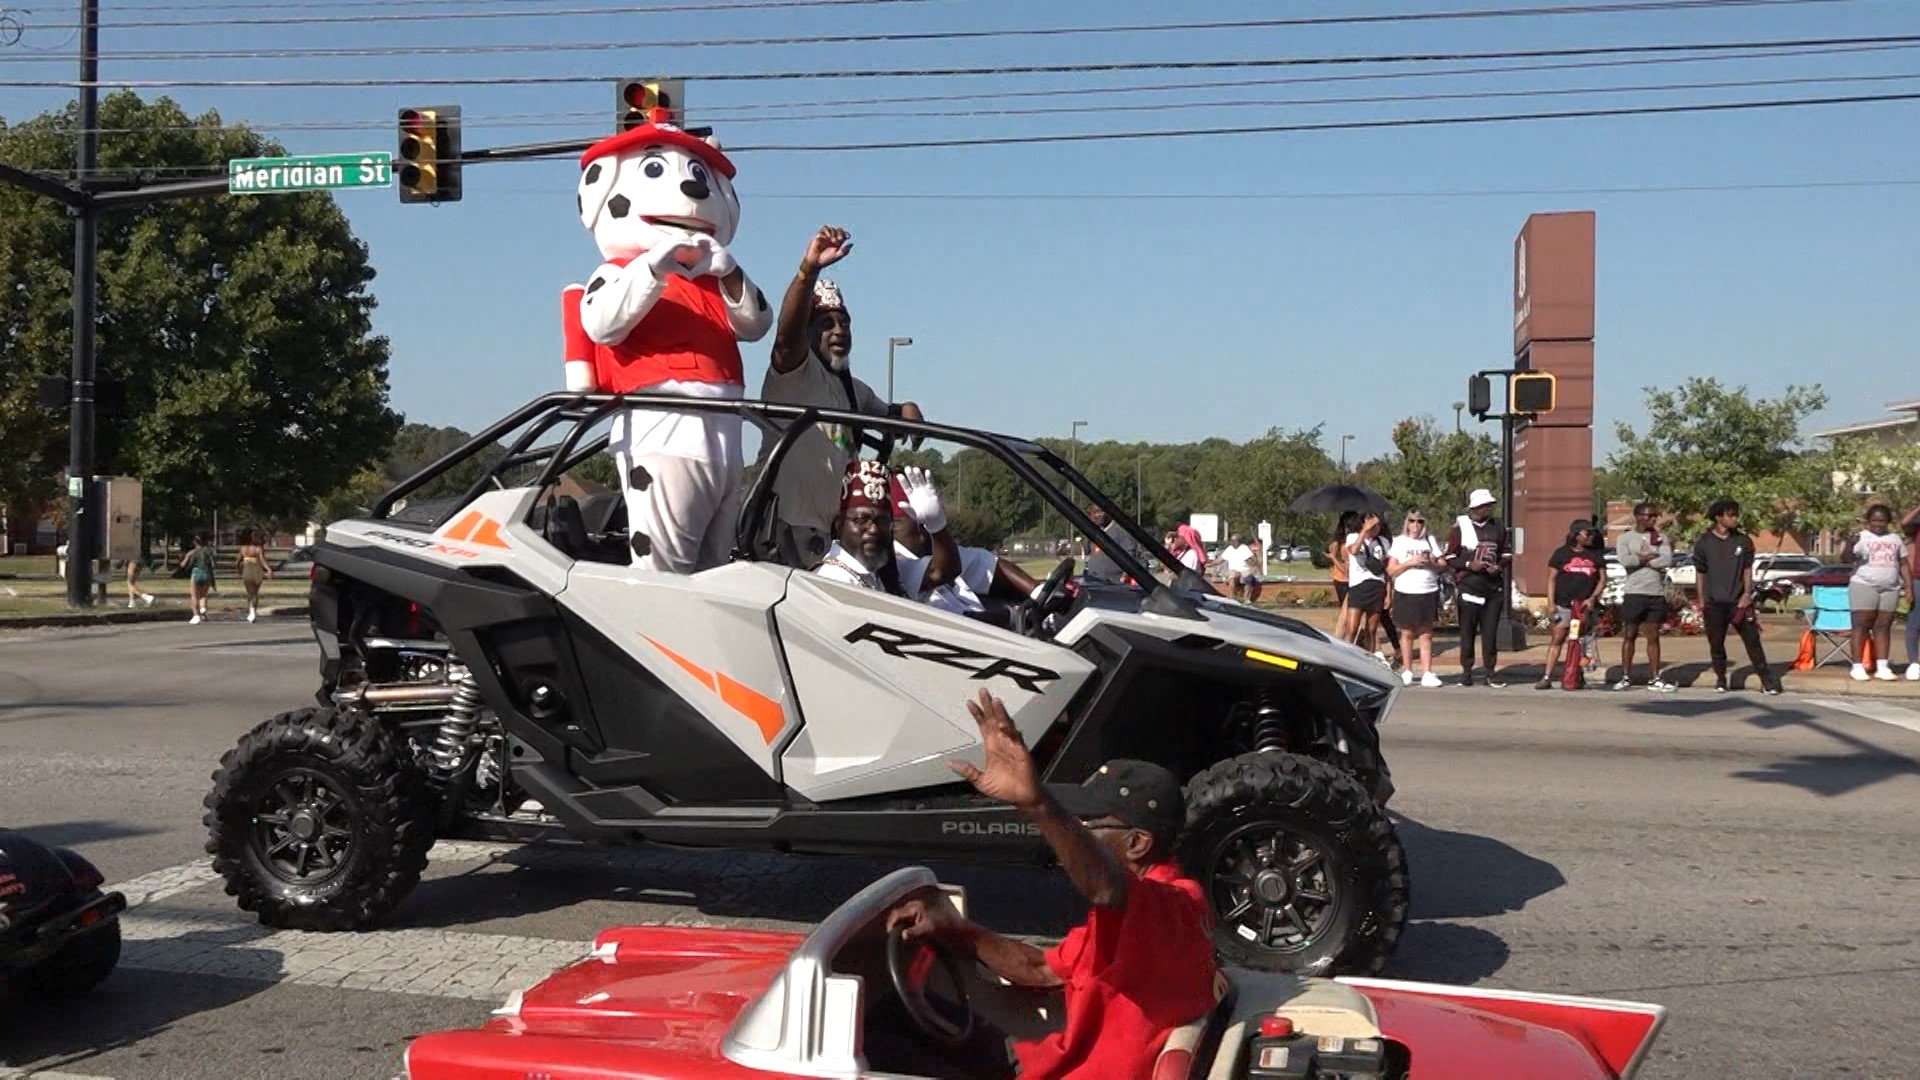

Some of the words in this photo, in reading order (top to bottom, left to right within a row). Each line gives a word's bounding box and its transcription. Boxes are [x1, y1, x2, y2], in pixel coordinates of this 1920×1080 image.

[235, 162, 343, 189] Meridian
[359, 158, 385, 183] St
[843, 622, 1062, 695] RZR
[942, 821, 1041, 836] POLARIS
